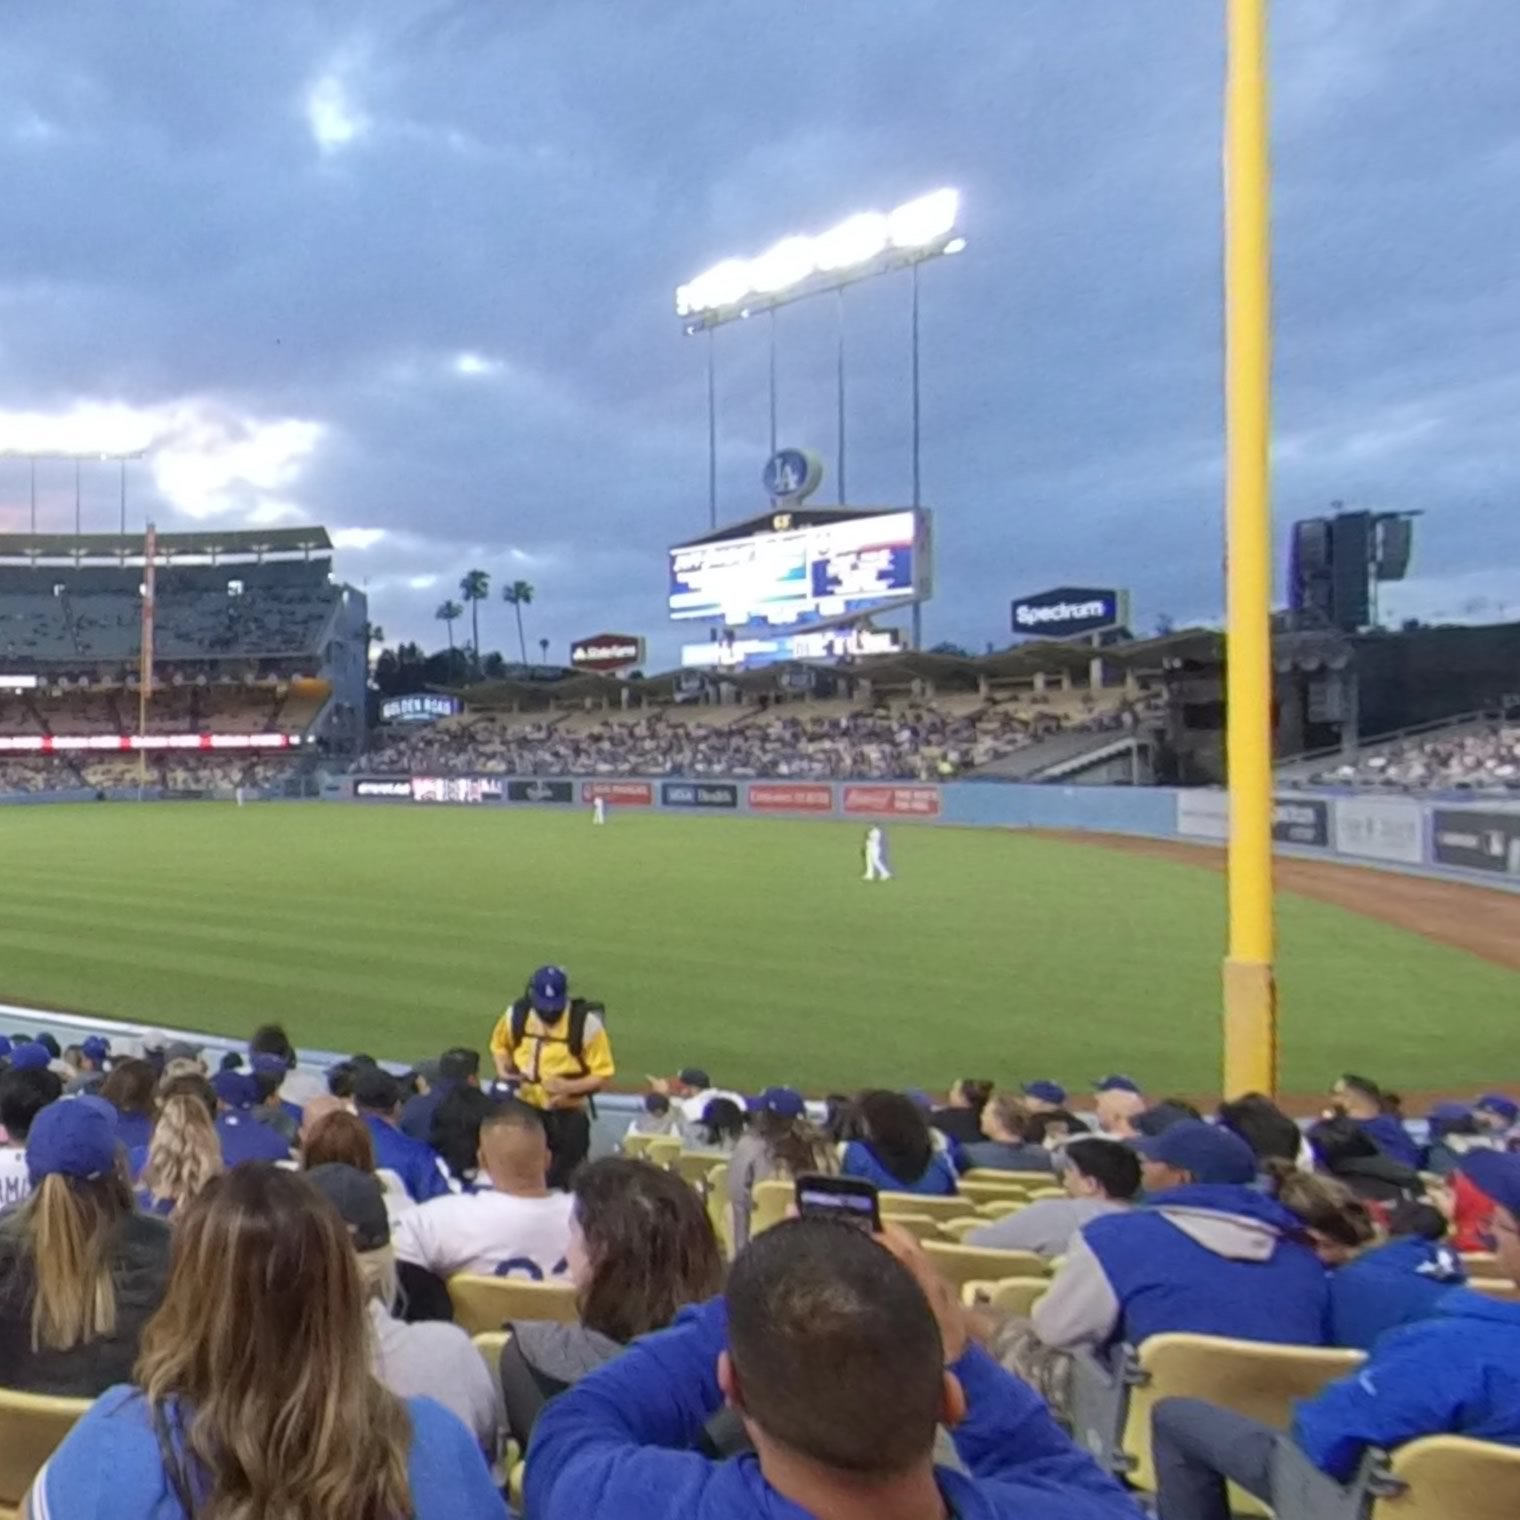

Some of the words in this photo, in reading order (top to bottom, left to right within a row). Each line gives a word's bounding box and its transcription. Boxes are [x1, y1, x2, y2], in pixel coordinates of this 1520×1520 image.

[1016, 600, 1104, 625] Spectrum
[382, 698, 421, 718] GOLDEN
[423, 698, 451, 716] ROAD
